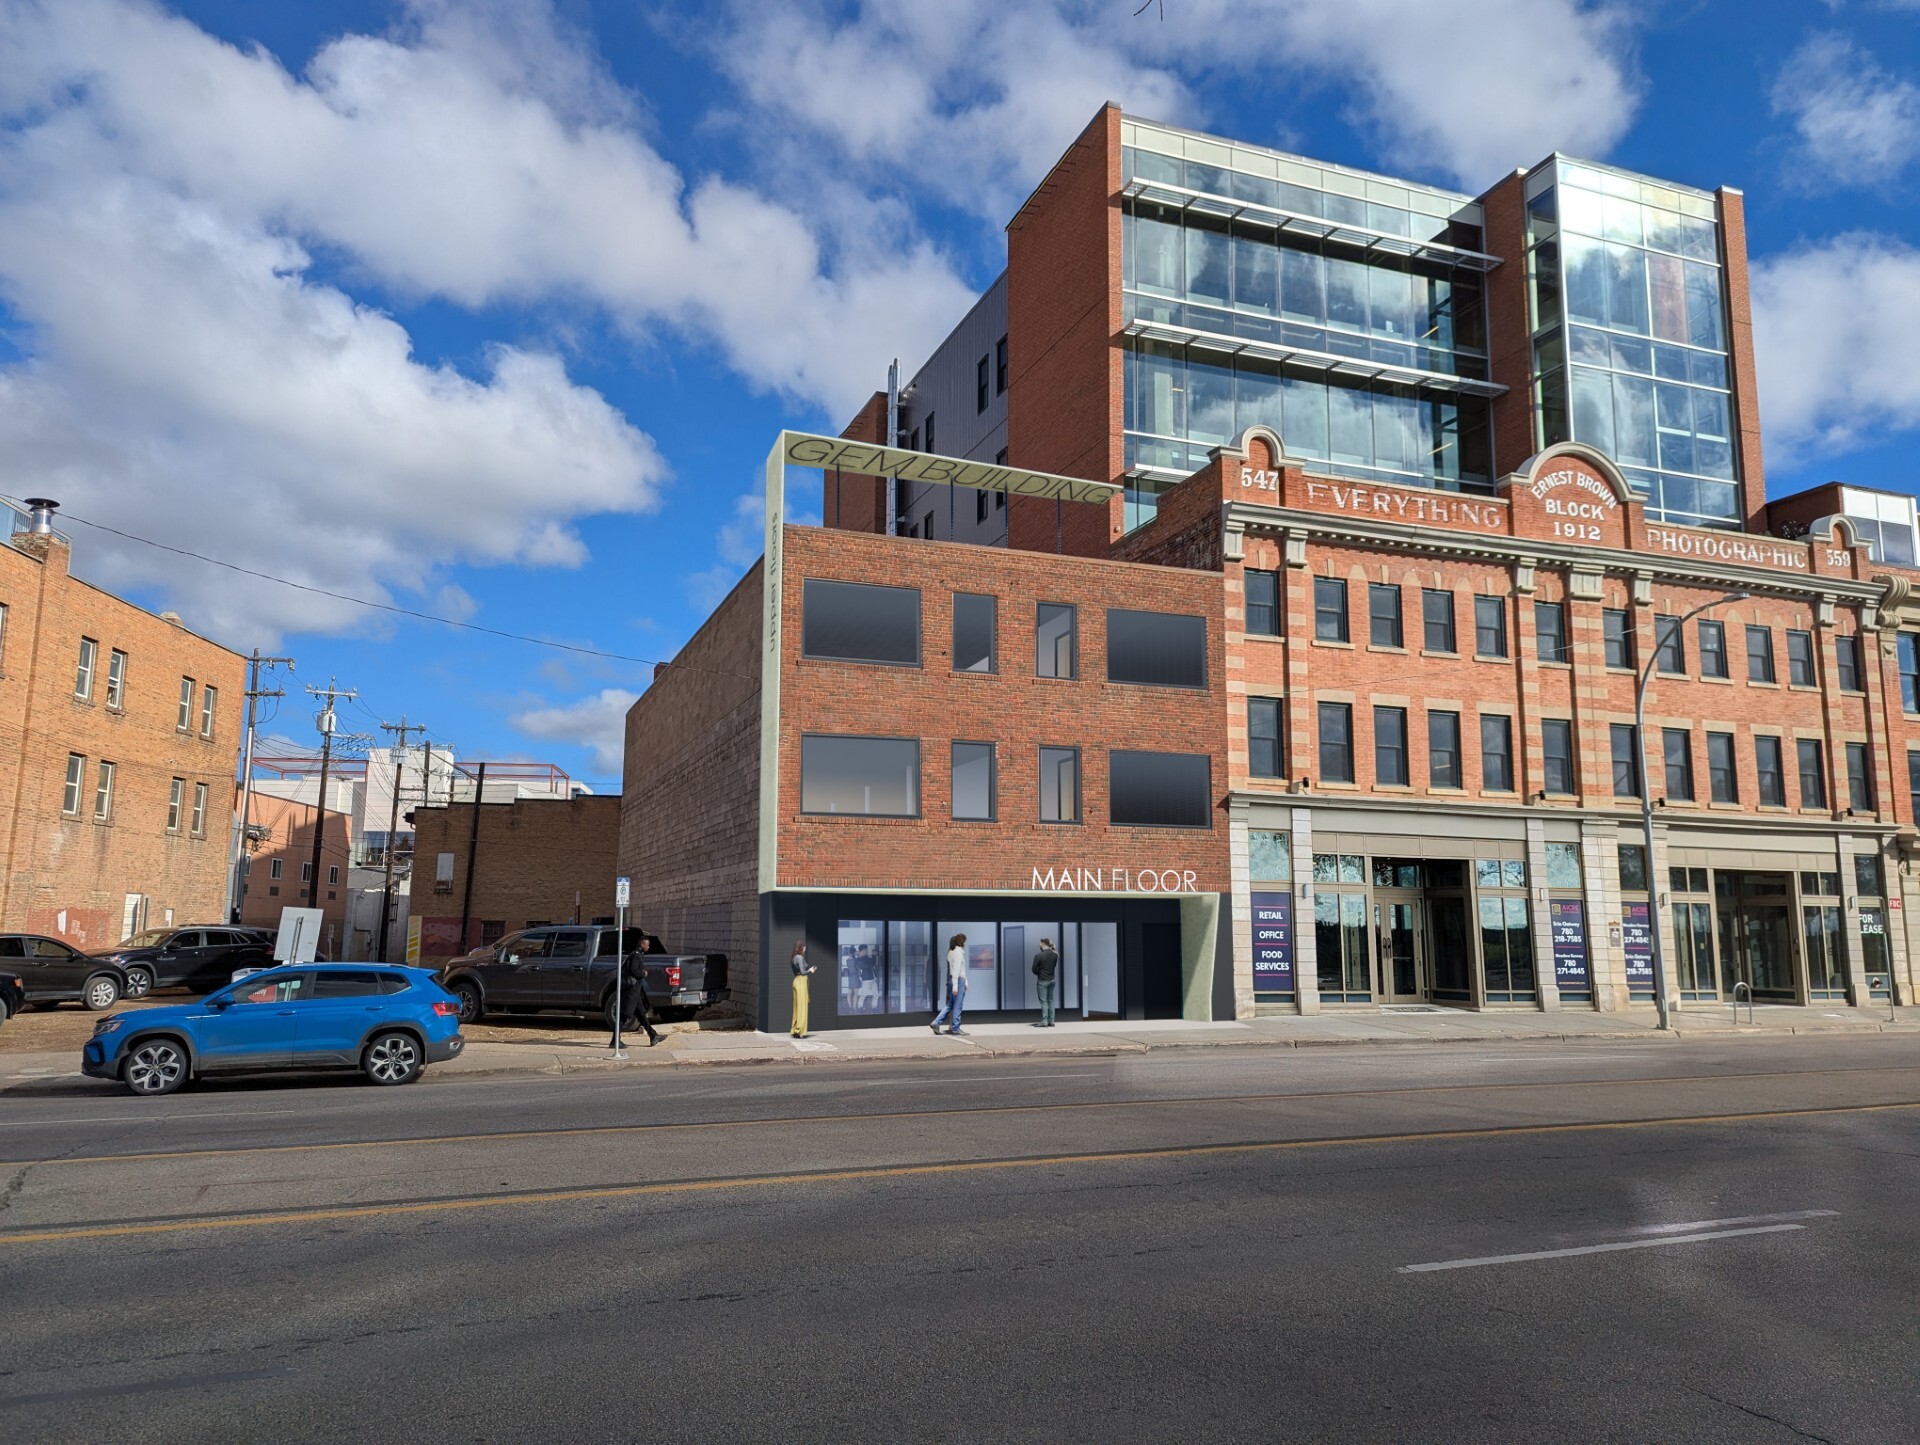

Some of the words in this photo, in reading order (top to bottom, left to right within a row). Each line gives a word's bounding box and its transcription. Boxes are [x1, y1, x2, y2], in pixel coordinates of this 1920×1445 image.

[789, 439, 918, 474] GEM
[917, 459, 1115, 504] BUILDING
[1241, 467, 1279, 491] 547
[1531, 470, 1574, 500] ERNEST
[1576, 472, 1618, 510] BROWN
[1306, 482, 1502, 528] EVERYTHING
[1545, 499, 1605, 520] BLOCK
[1553, 521, 1601, 540] 1912
[1647, 529, 1807, 569] PHOTOGRAPHIC
[1826, 549, 1851, 567] 559
[1031, 866, 1102, 890] MAIN
[1112, 868, 1197, 892] FLOOR
[1258, 911, 1283, 919] RETAIL
[1259, 930, 1284, 939] OFFICE
[1554, 935, 1582, 943] 218-7585
[1255, 962, 1290, 970] SERVICES
[1556, 967, 1585, 975] 271-4845
[1563, 959, 1576, 967] 780
[1626, 967, 1653, 975] 218-7585
